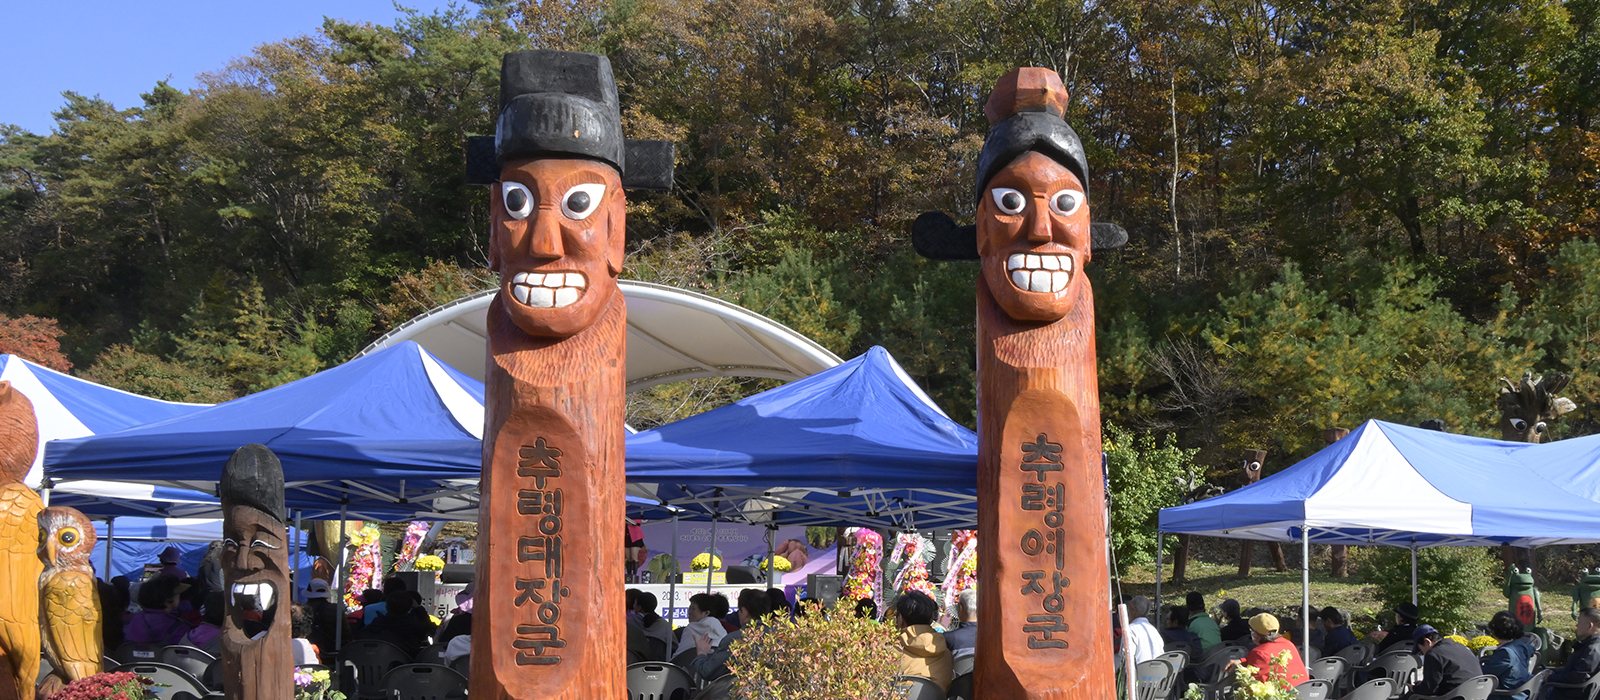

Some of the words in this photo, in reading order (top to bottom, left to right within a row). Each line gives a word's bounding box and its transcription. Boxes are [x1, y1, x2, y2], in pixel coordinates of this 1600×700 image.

[512, 437, 570, 666] 추령대장군
[661, 591, 681, 601] 203.
[1019, 433, 1070, 649] 추령여장군
